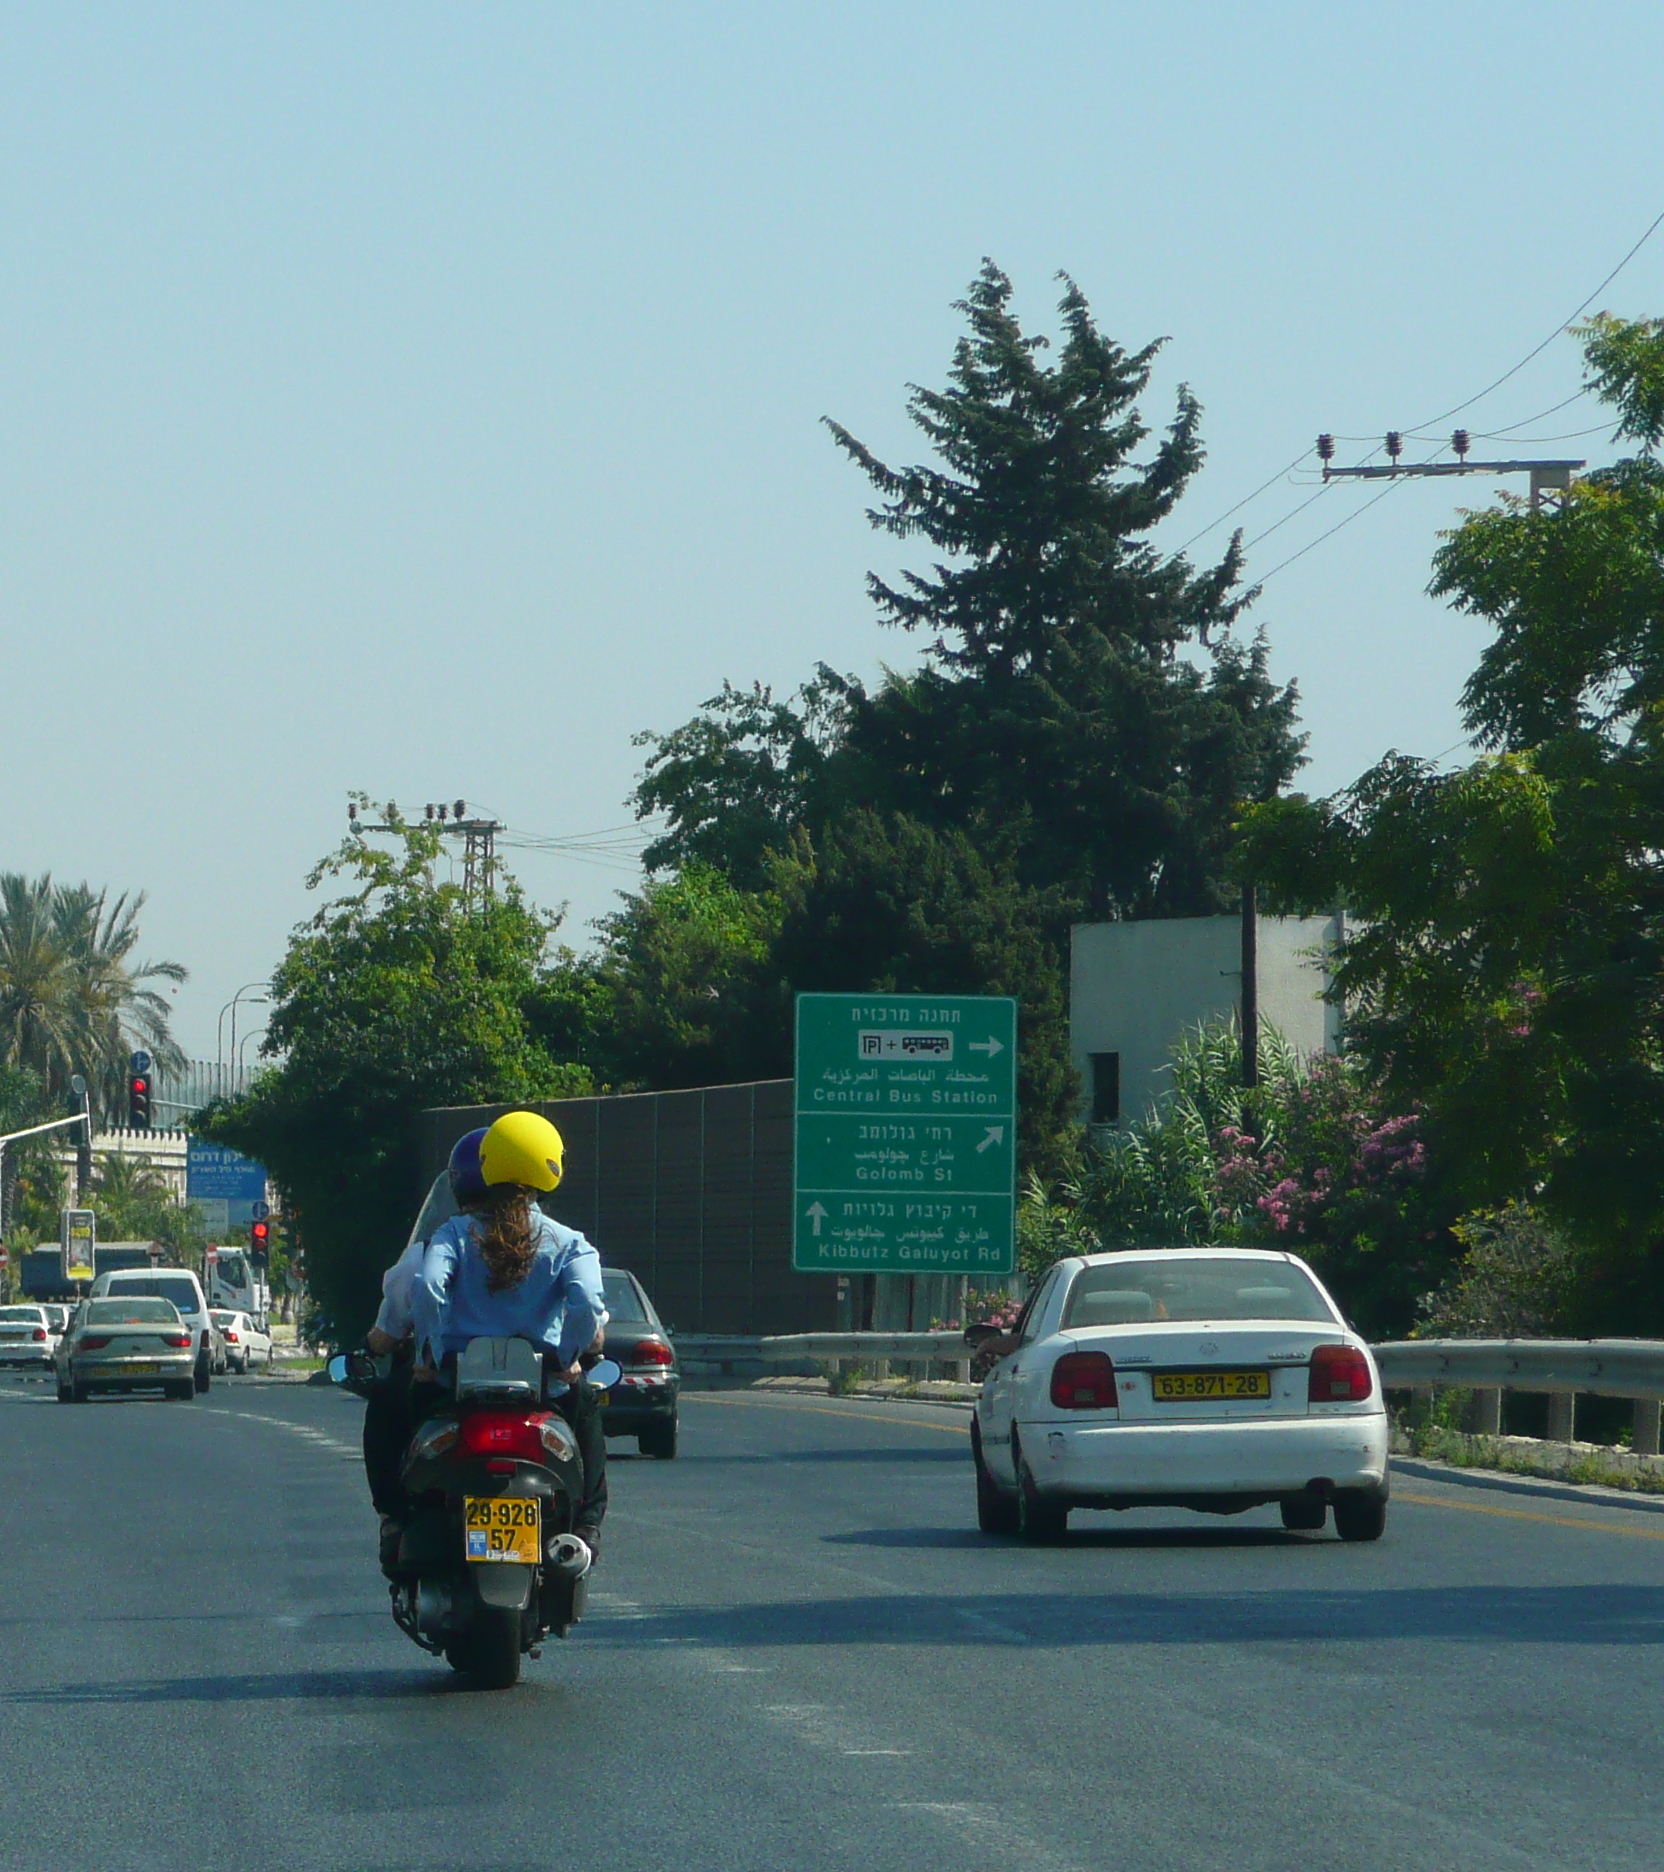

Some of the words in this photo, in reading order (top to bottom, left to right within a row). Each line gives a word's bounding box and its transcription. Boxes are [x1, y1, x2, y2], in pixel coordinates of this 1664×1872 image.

[851, 1007, 910, 1023] מרכזית
[919, 1008, 962, 1023] תחנה
[945, 1068, 989, 1082] محطة
[813, 1088, 880, 1101] Central
[889, 1090, 921, 1102] Bus
[932, 1090, 997, 1103] Station
[858, 1124, 916, 1140] גולומב
[855, 1166, 924, 1180] Golomb
[934, 1167, 953, 1181] St
[843, 1202, 895, 1217] גלויות
[905, 1203, 952, 1220] קיבוץ
[818, 1243, 889, 1258] Kibbutz
[898, 1247, 970, 1262] Galuyot
[978, 1248, 1001, 1261] Rd
[491, 1528, 516, 1550] 57
